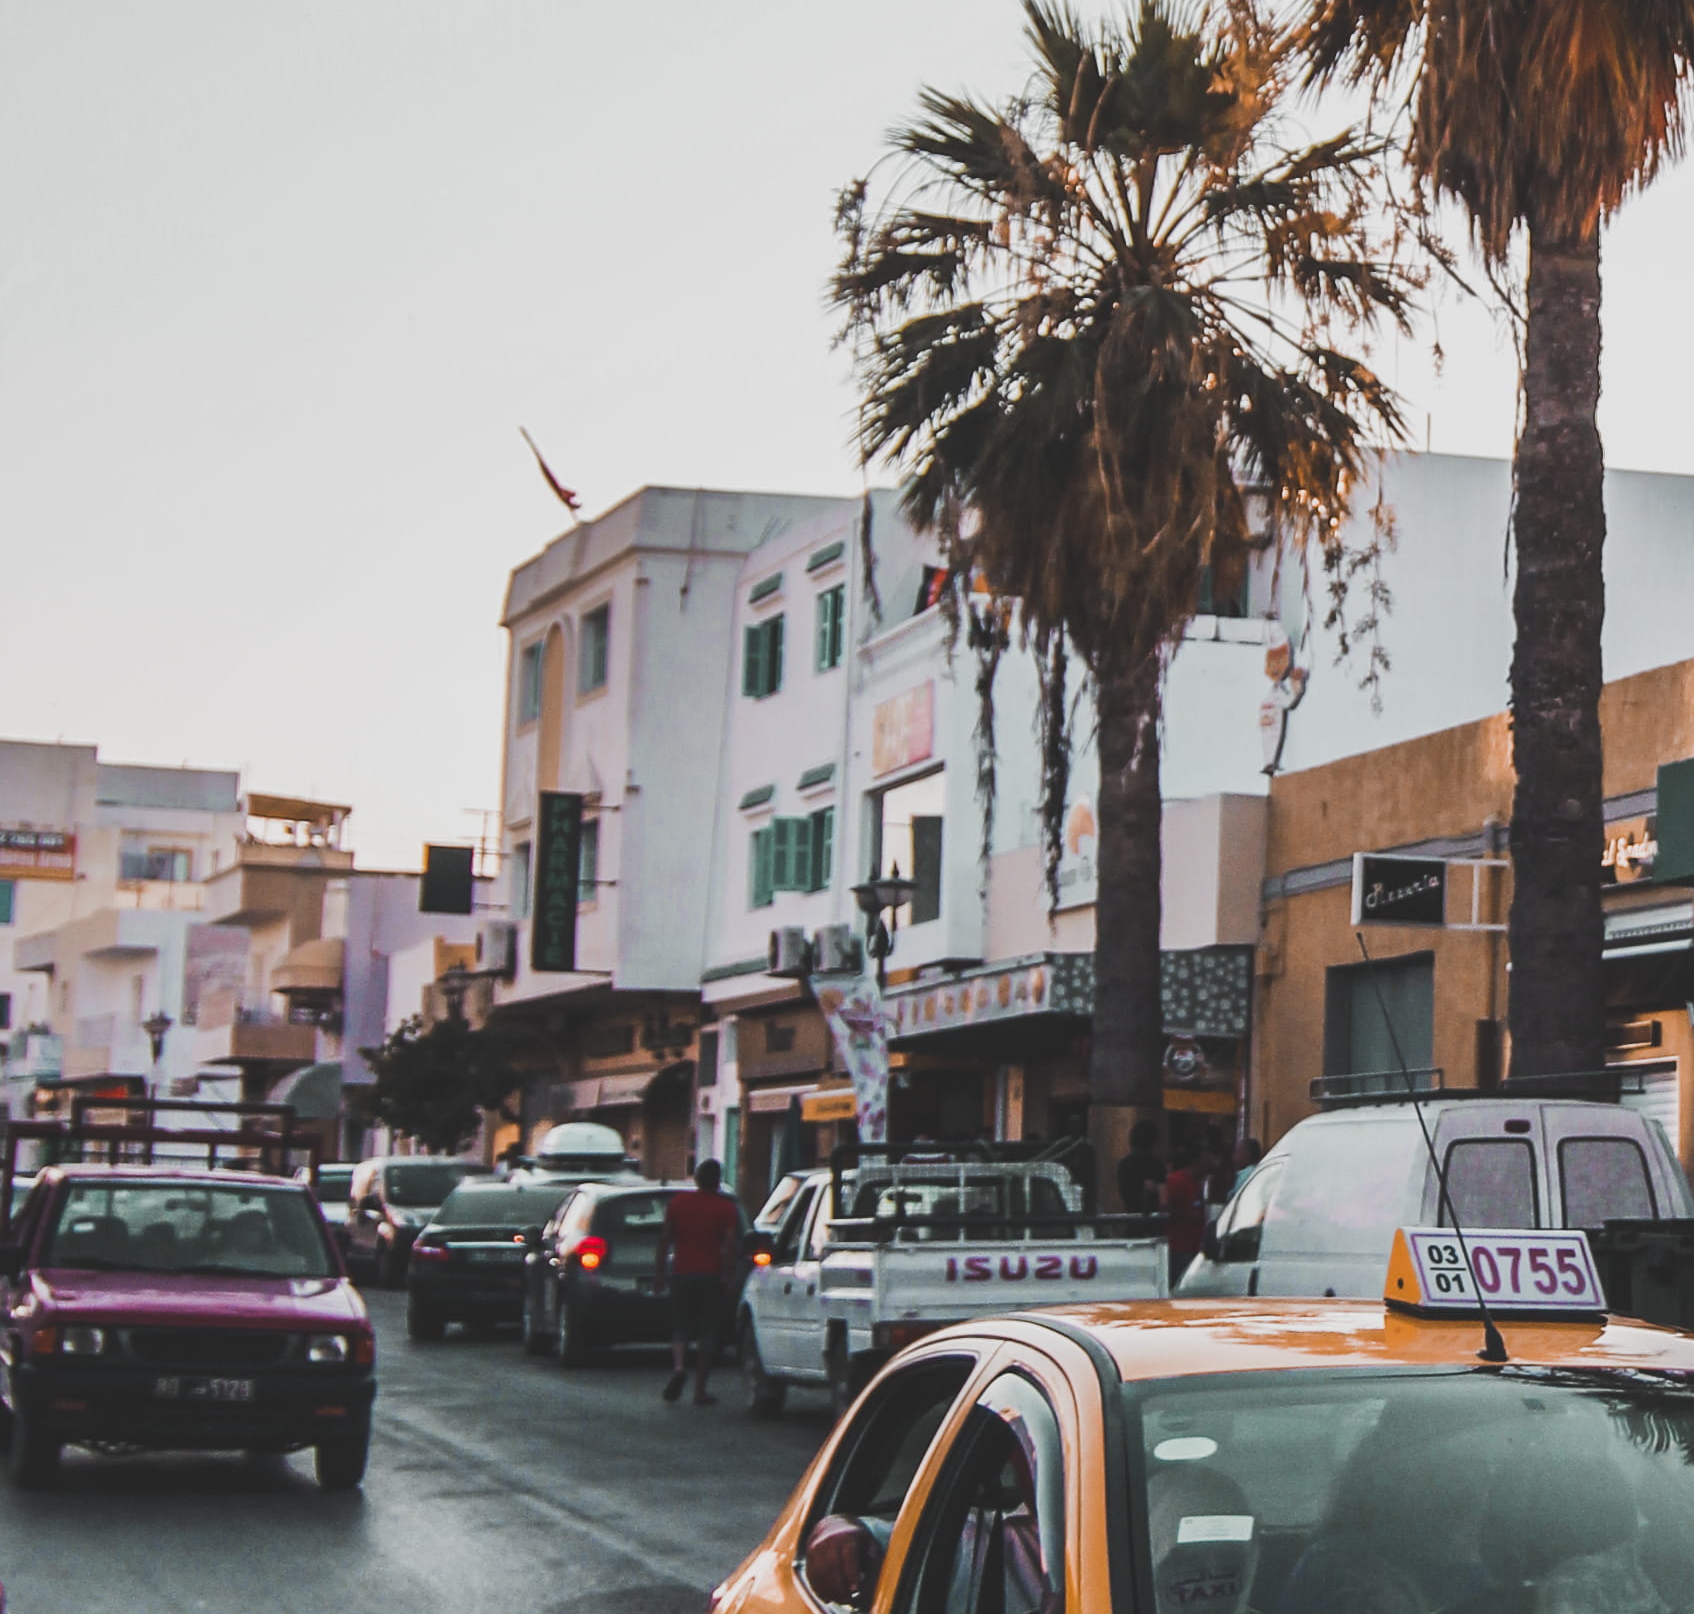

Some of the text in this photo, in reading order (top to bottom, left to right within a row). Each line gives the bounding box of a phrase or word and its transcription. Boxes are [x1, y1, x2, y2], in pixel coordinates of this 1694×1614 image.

[546, 797, 572, 964] PHARMACIE
[947, 1255, 1098, 1282] ISUZU
[1428, 1245, 1587, 1296] 03 0755
[1436, 1273, 1465, 1293] 01
